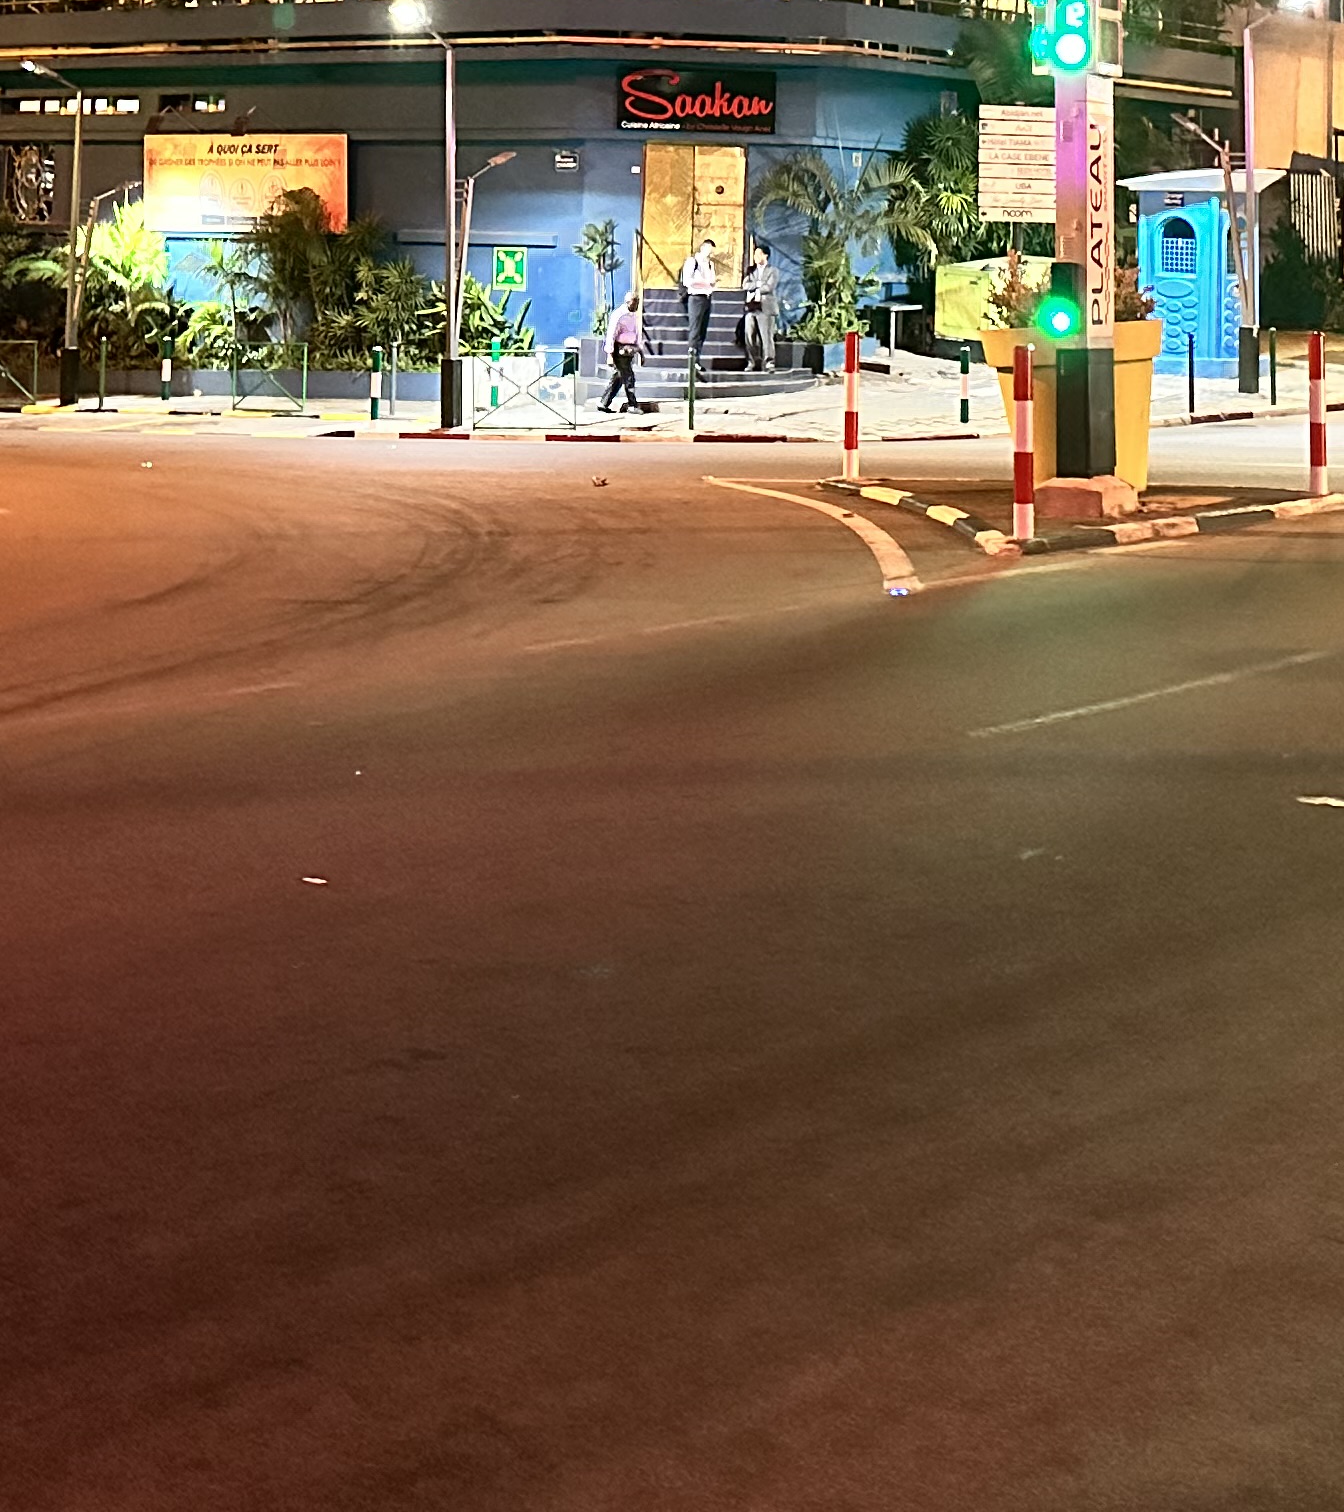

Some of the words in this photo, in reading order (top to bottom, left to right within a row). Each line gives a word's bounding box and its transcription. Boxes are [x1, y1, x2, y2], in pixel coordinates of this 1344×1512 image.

[621, 69, 774, 120] Saakan
[216, 144, 239, 156] QUOI
[241, 144, 253, 157] ÇA
[255, 144, 279, 155] SERT
[1003, 210, 1032, 218] noom
[1090, 123, 1103, 325] PLATEAU
